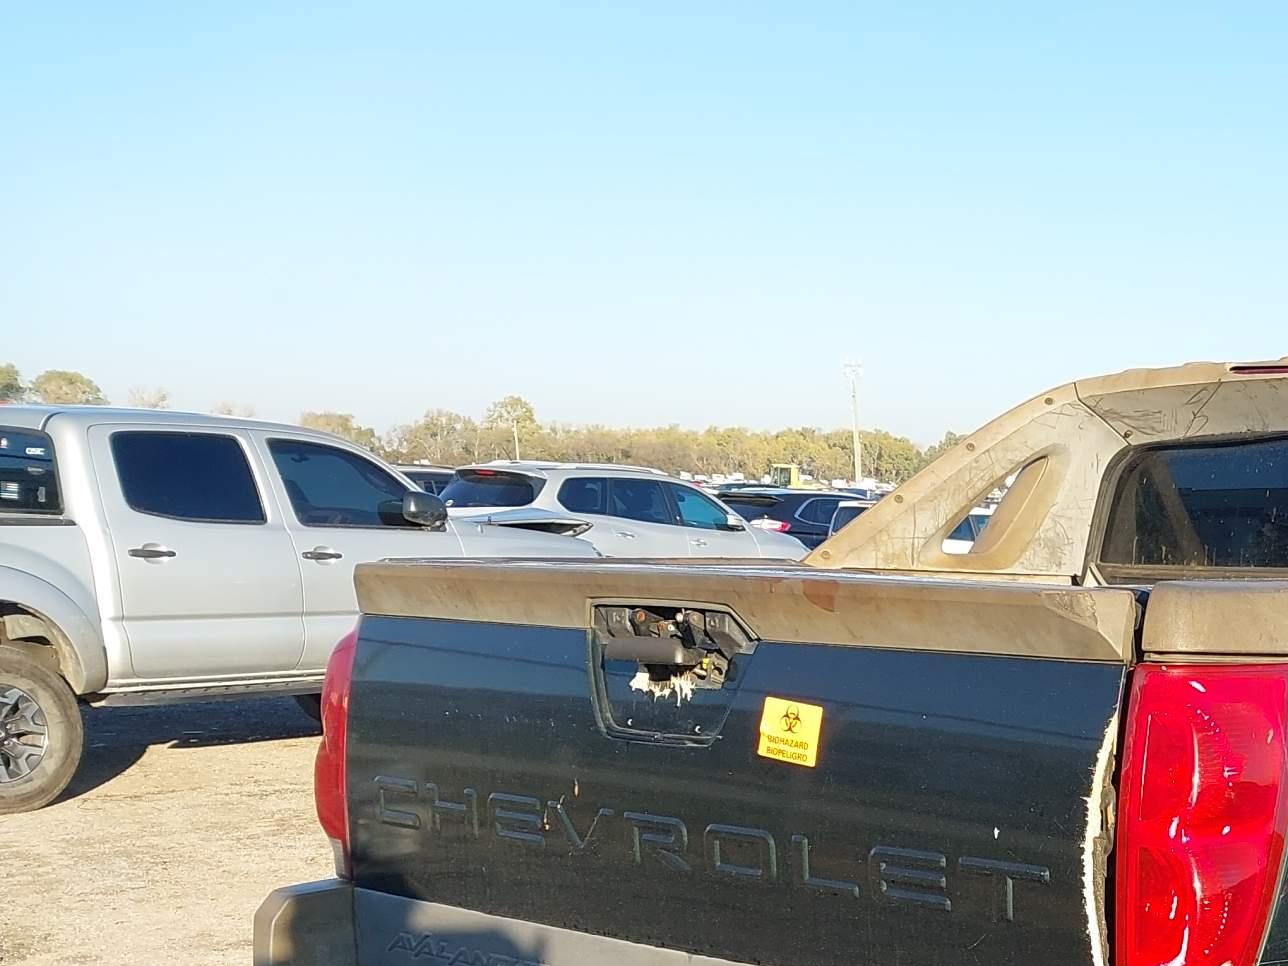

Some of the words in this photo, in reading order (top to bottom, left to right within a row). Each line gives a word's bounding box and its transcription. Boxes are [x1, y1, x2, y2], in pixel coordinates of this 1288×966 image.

[767, 734, 809, 751] BIOHAZARD
[766, 746, 808, 762] BIOPELIGRO
[372, 774, 1051, 922] CHEVROLET
